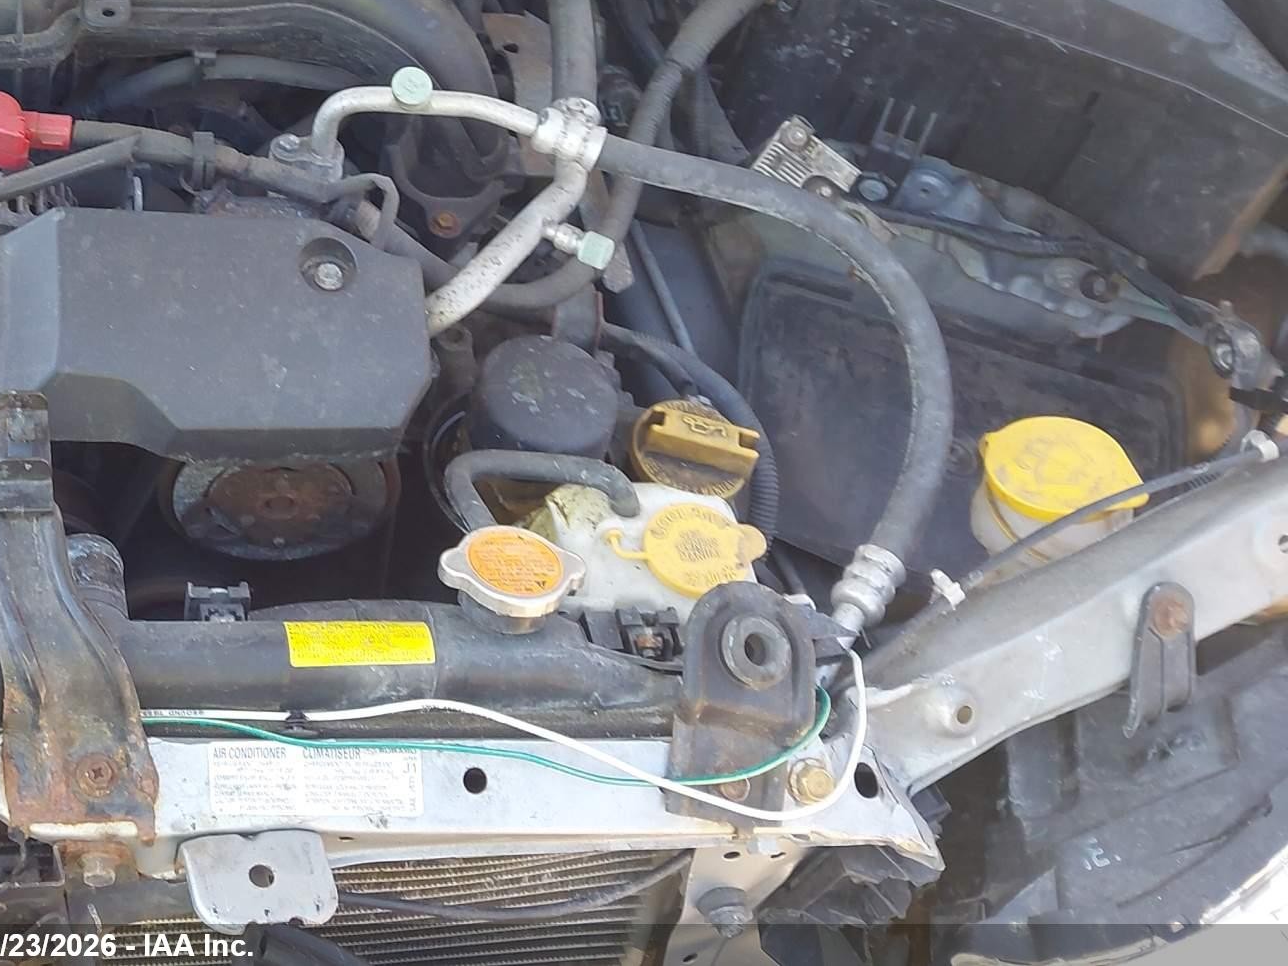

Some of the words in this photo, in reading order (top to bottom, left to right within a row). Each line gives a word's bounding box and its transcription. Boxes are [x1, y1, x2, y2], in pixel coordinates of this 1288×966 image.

[213, 747, 227, 759] AIR
[228, 747, 287, 759] CONDITIONER
[302, 745, 361, 760] CLIMATISEUR
